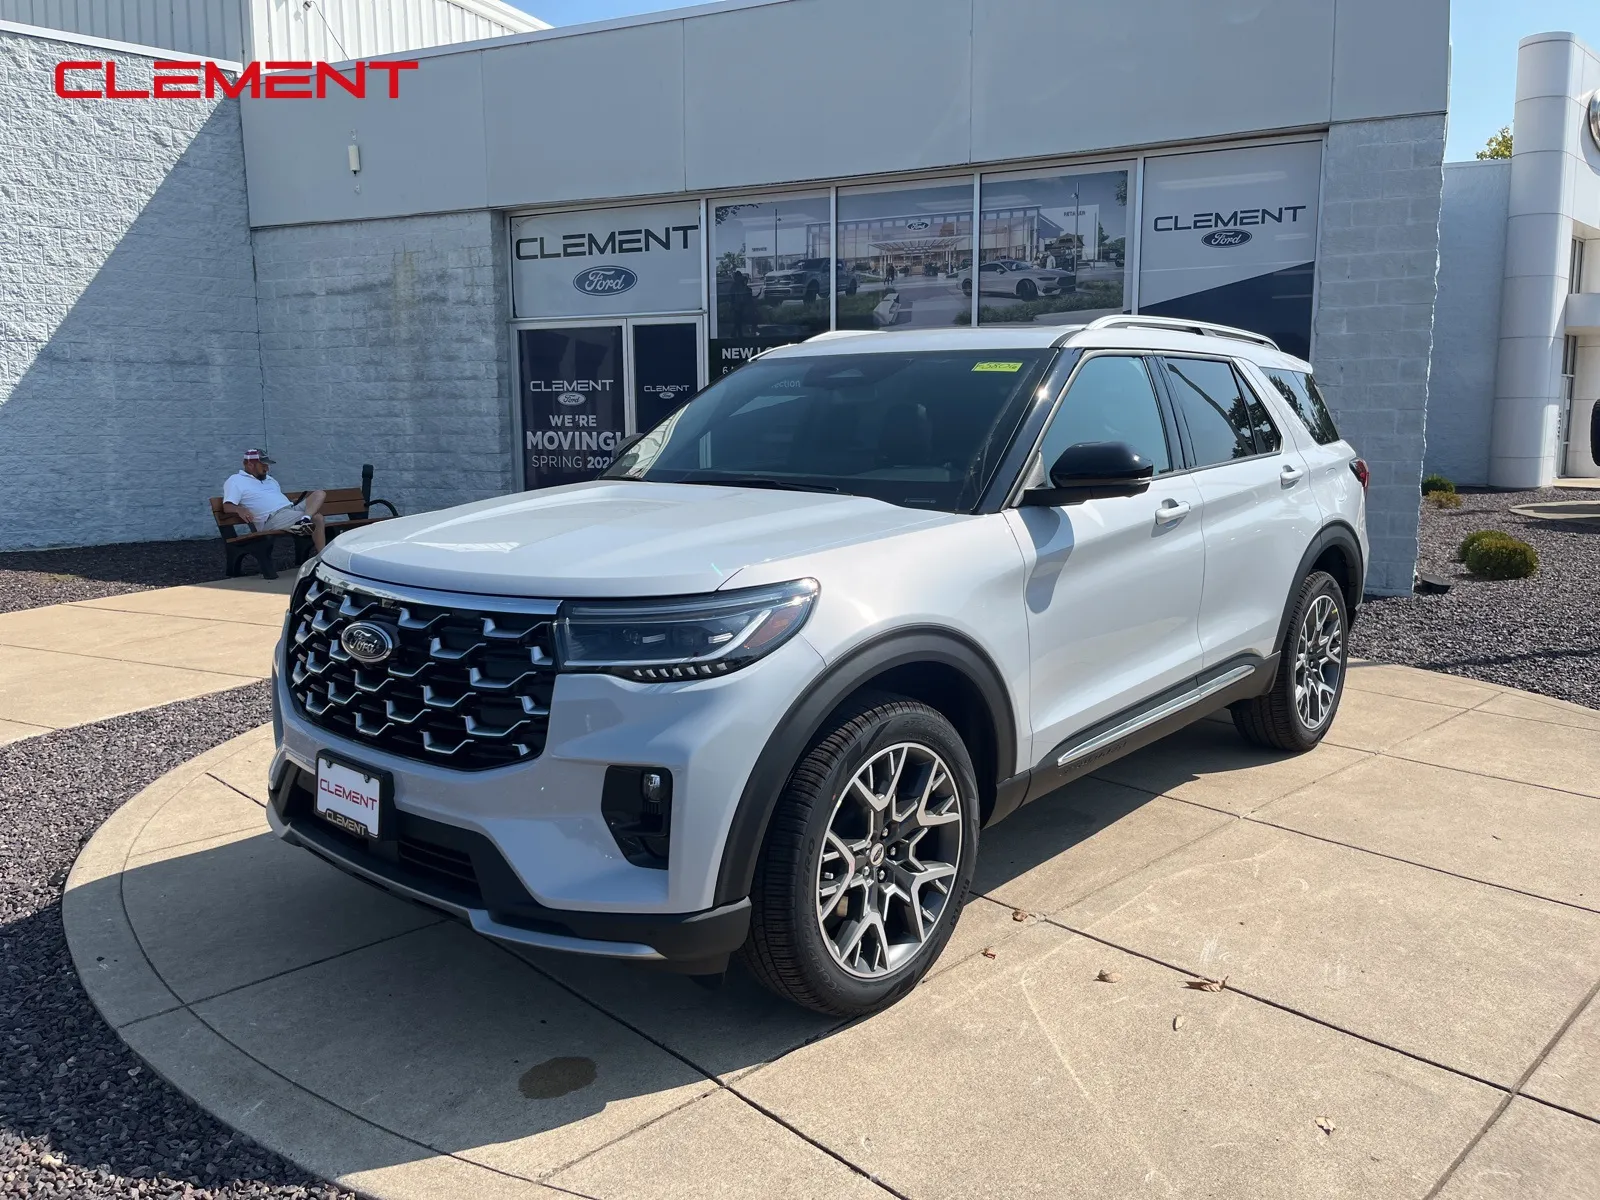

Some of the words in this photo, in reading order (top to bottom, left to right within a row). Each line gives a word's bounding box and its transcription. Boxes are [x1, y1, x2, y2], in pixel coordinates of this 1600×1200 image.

[1153, 205, 1306, 232] CLEMENT
[515, 225, 699, 261] CLEMENT
[1211, 231, 1242, 245] Ford
[585, 270, 626, 292] Ford
[721, 347, 753, 359] NEW
[530, 379, 614, 392] CLEMENT
[643, 384, 690, 392] CLEMENT
[549, 414, 597, 427] WE'RE
[531, 455, 582, 468] SPRING
[350, 630, 378, 654] Ford
[320, 778, 377, 811] CLEMENT
[326, 810, 367, 836] CLEMENT
[801, 837, 816, 905] ZERO
